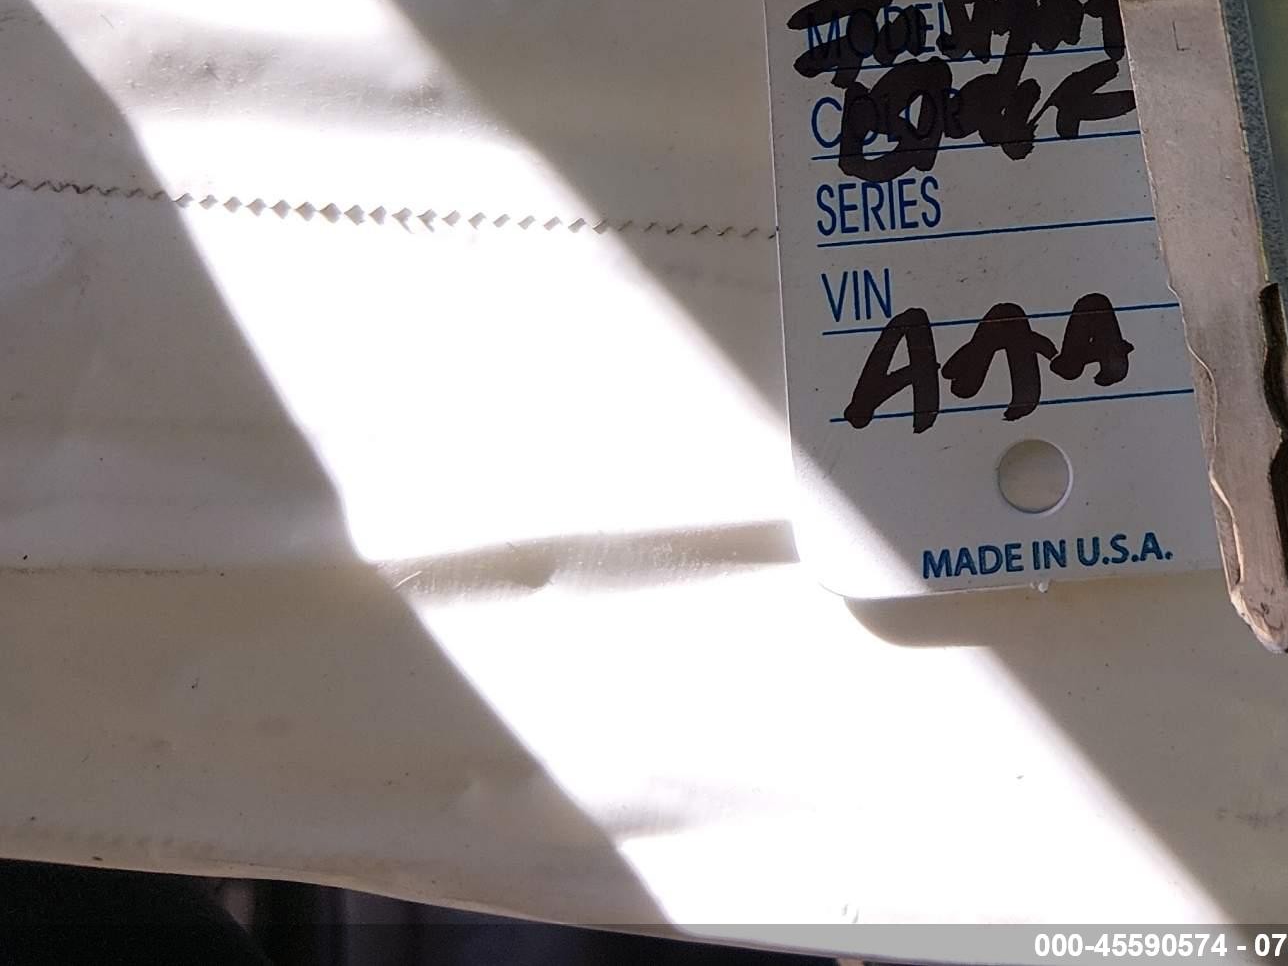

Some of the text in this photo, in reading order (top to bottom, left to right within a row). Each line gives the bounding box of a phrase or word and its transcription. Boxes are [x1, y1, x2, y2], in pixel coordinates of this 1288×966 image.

[815, 174, 942, 236] SERIES
[821, 267, 893, 323] VIN
[922, 531, 1173, 579] MADE IN U.S.A.
